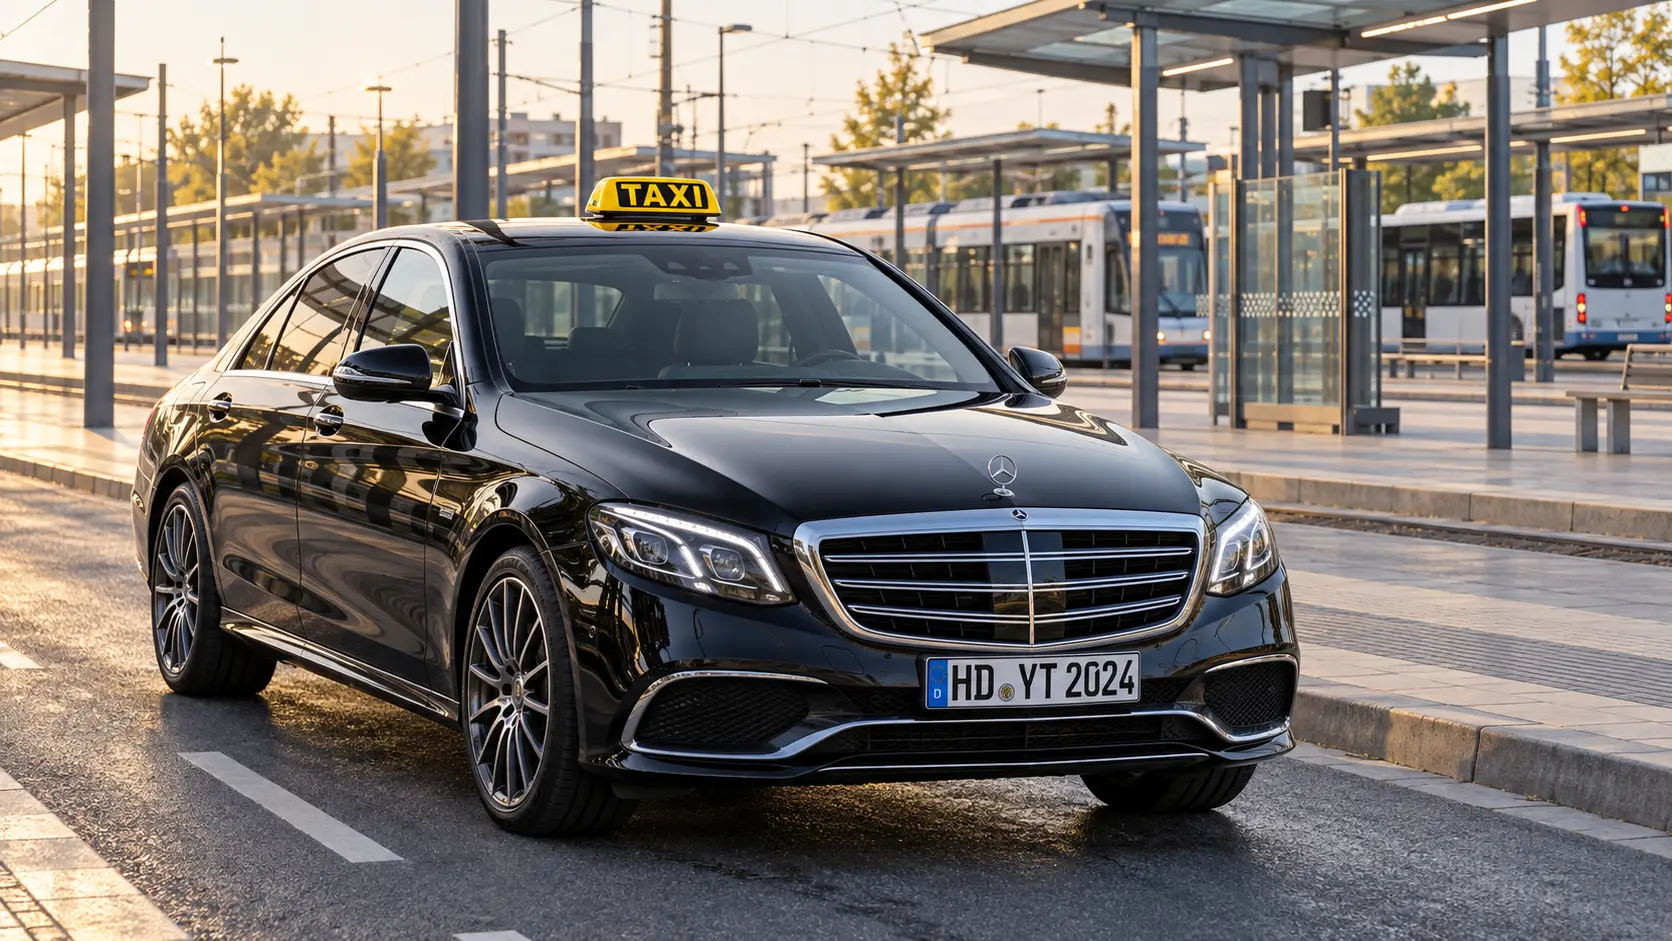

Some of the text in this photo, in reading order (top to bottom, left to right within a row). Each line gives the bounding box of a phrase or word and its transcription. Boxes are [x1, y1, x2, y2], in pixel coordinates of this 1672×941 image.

[621, 184, 703, 207] TAXI
[952, 660, 1135, 701] HD YT 2024
[933, 688, 942, 699] D
